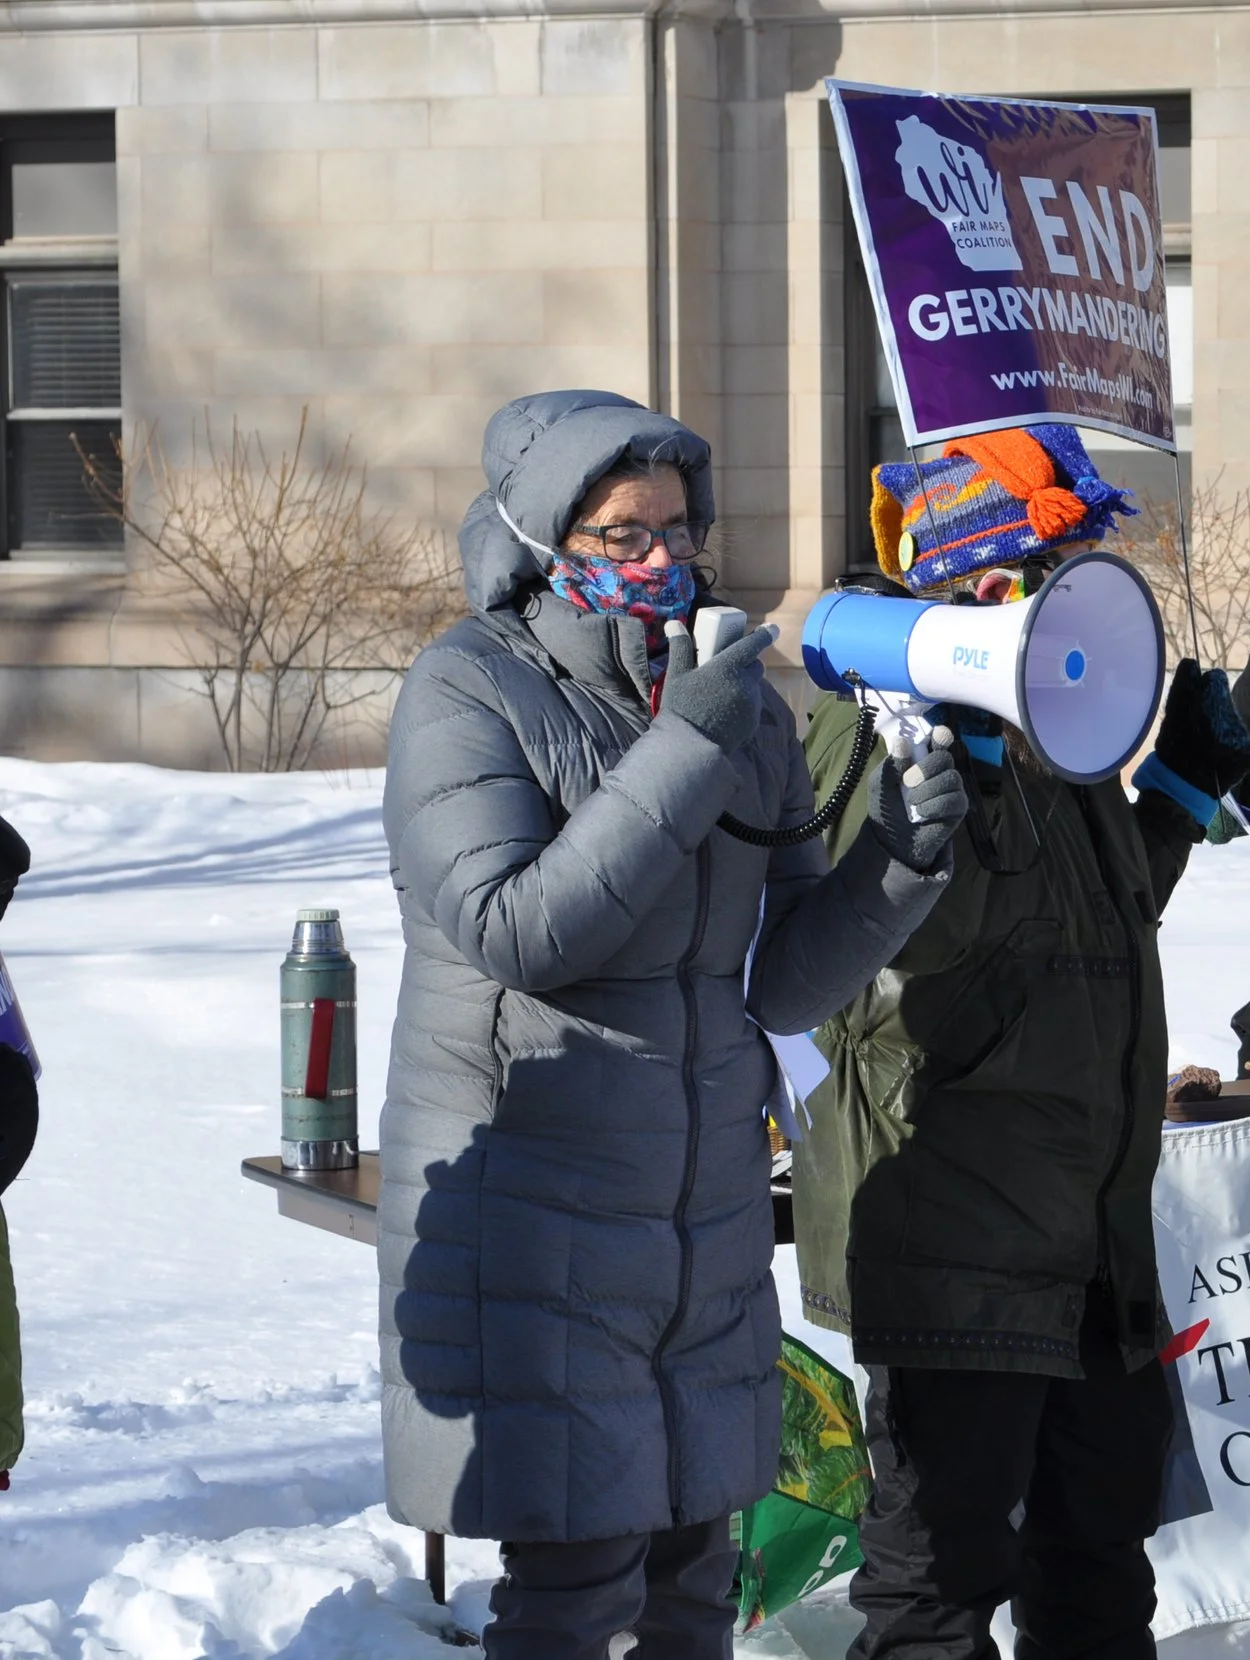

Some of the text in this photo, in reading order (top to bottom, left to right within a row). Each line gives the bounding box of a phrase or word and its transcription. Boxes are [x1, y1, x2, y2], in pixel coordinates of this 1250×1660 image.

[952, 221, 1006, 232] FAIR MAPS
[957, 237, 1012, 249] COALITION
[1019, 176, 1155, 292] END
[908, 286, 1167, 360] GERRYMANDERING
[990, 362, 1153, 409] www.FairMapsWI.com
[953, 646, 990, 670] PYLE
